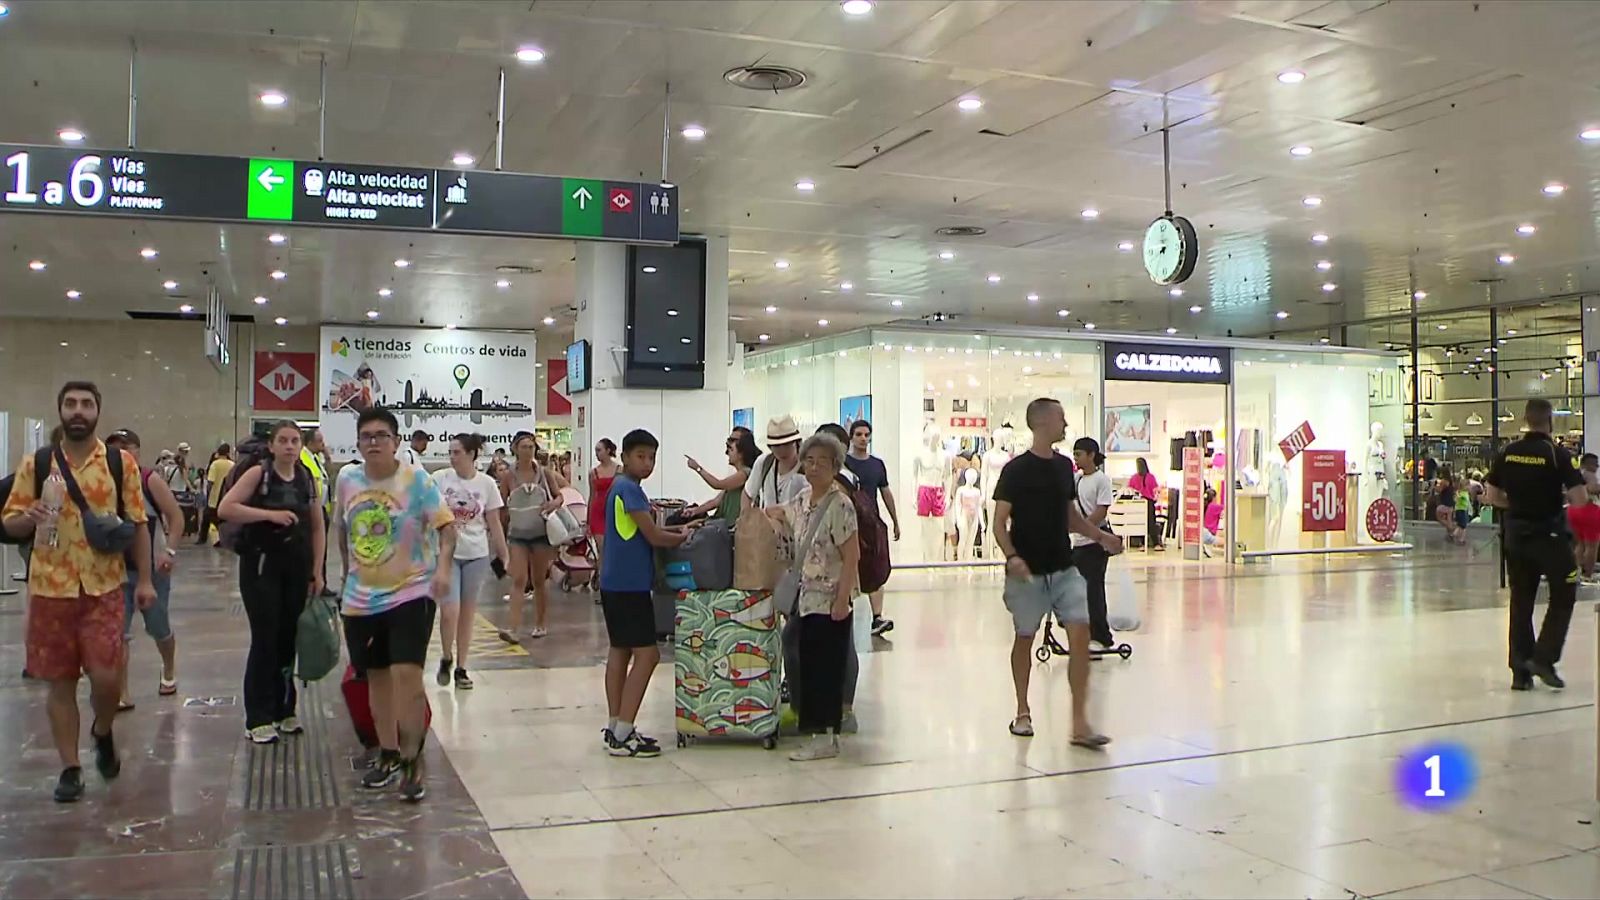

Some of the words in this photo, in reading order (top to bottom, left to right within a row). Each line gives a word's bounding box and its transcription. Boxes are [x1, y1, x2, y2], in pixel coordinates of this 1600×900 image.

[112, 157, 144, 175] Vías
[6, 152, 37, 203] 1
[44, 181, 63, 204] a
[70, 155, 104, 206] 6
[328, 170, 355, 186] Alta
[360, 173, 428, 190] velocidad
[110, 195, 163, 209] PLATFORMS
[326, 189, 356, 204] Alta
[360, 191, 424, 208] velocitat
[326, 207, 348, 218] HIGH
[350, 208, 377, 219] SPEED
[353, 337, 412, 352] tiendas
[424, 342, 475, 355] Centros
[479, 344, 495, 356] de
[499, 345, 527, 358] vida
[1115, 352, 1222, 373] CALZEDONIA
[274, 372, 295, 391] M
[1304, 481, 1344, 521] -50%
